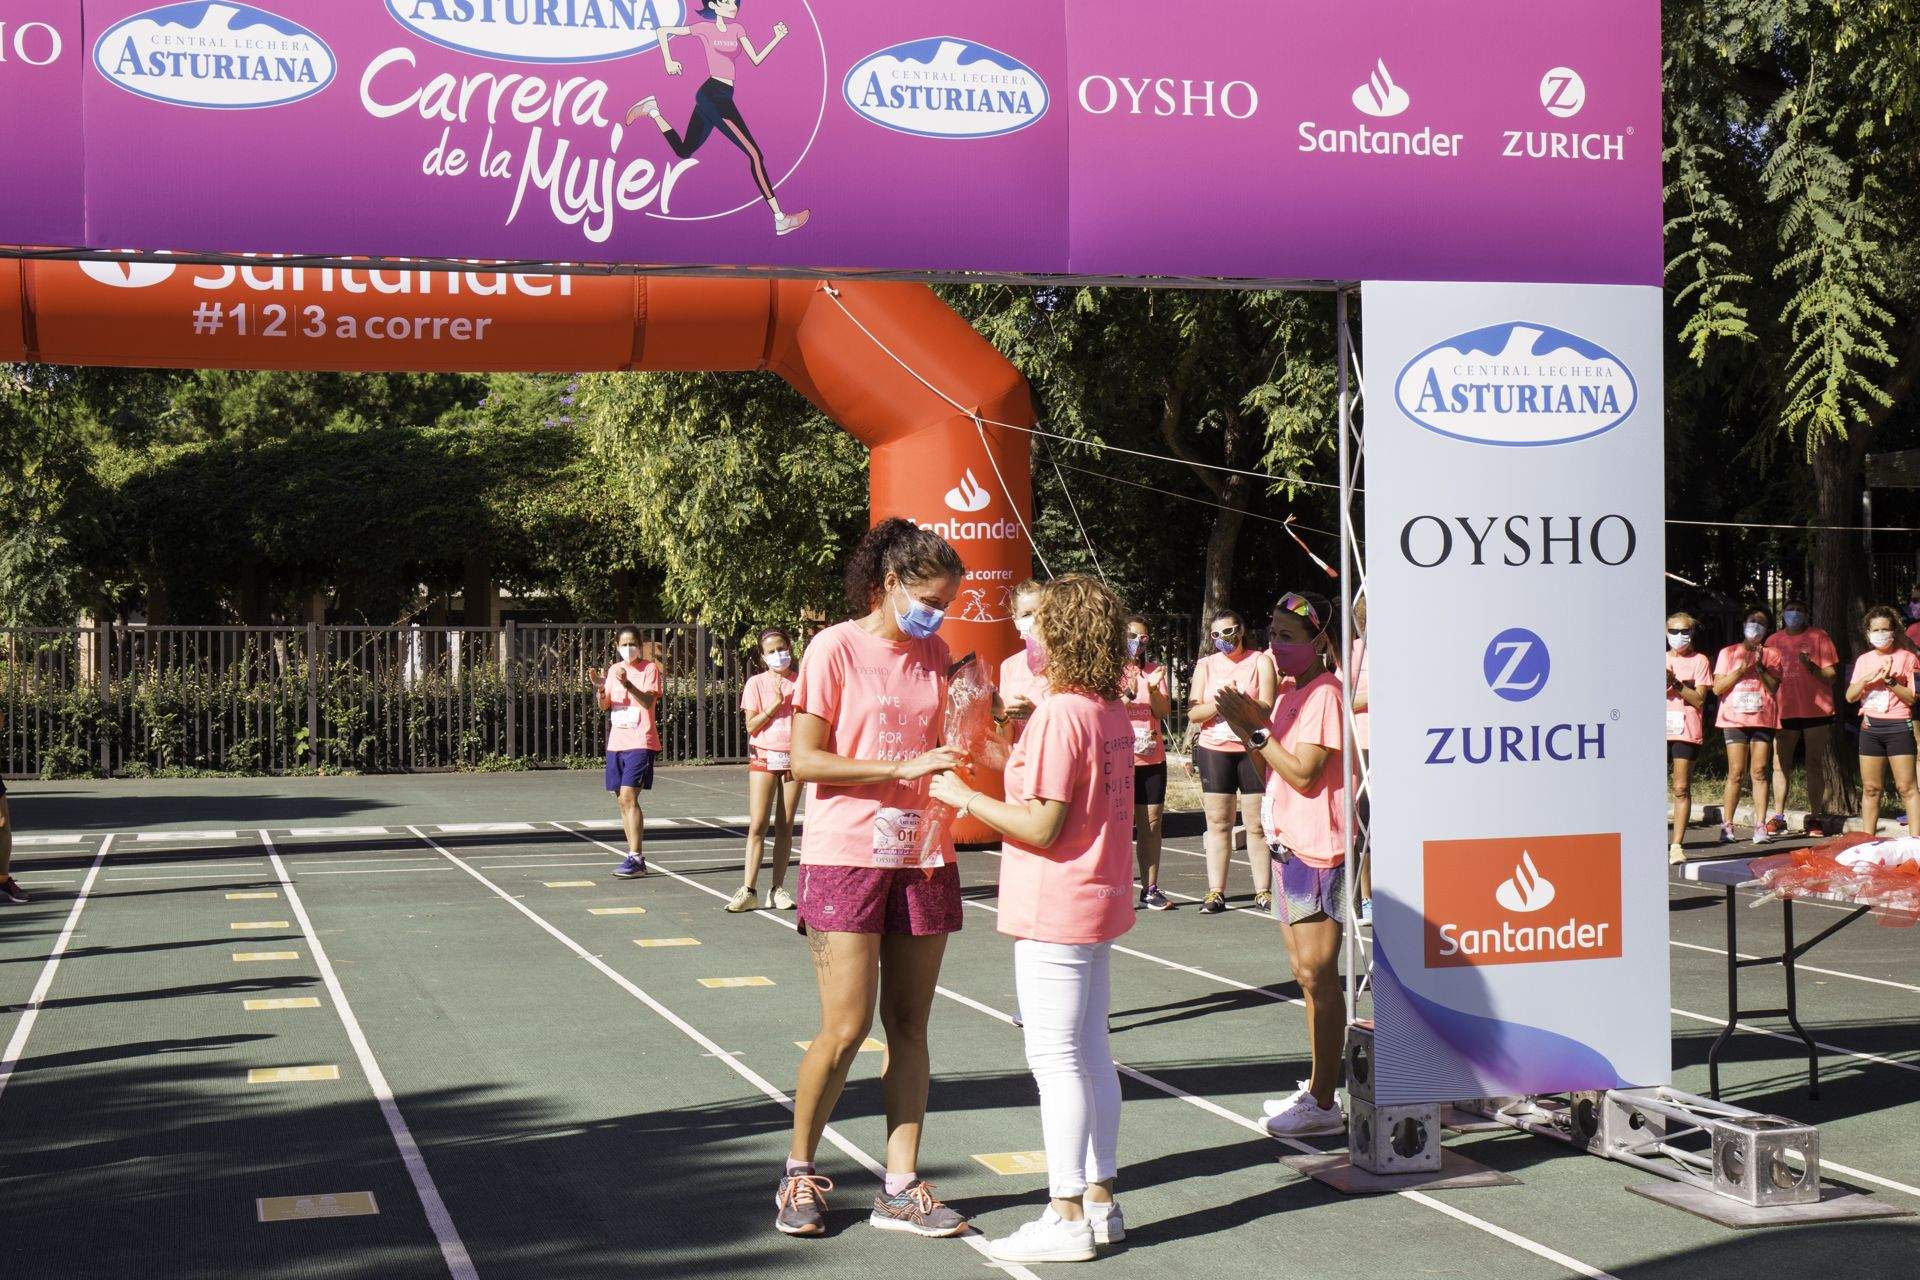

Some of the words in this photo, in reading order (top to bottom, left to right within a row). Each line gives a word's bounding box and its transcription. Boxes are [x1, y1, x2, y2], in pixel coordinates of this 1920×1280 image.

[113, 35, 319, 84] ASTURIANA
[151, 36, 226, 48] CENTRAL
[235, 39, 310, 52] LECHERA
[360, 47, 609, 128] Carrera
[860, 70, 1034, 115] ASTURIANA
[892, 70, 957, 82] CENTRAL
[963, 74, 1027, 86] LECHERA
[1078, 75, 1259, 119] OYSHO
[1298, 121, 1464, 158] Santander
[1502, 130, 1625, 161] ZURICH
[422, 126, 469, 177] de
[479, 126, 512, 179] la
[505, 122, 700, 243] Mujer
[336, 315, 357, 340] a
[364, 314, 492, 341] correr
[1453, 364, 1531, 377] CENTRAL
[1539, 366, 1613, 378] LECHERA
[1414, 366, 1621, 415] ASTURIANA
[906, 517, 1020, 541] ntander
[1400, 514, 1637, 568] OYSHO
[975, 570, 1013, 580] correr
[877, 695, 901, 708] WE
[878, 731, 903, 745] FOR
[1424, 723, 1607, 765] ZURICH
[1439, 918, 1610, 957] Santander
